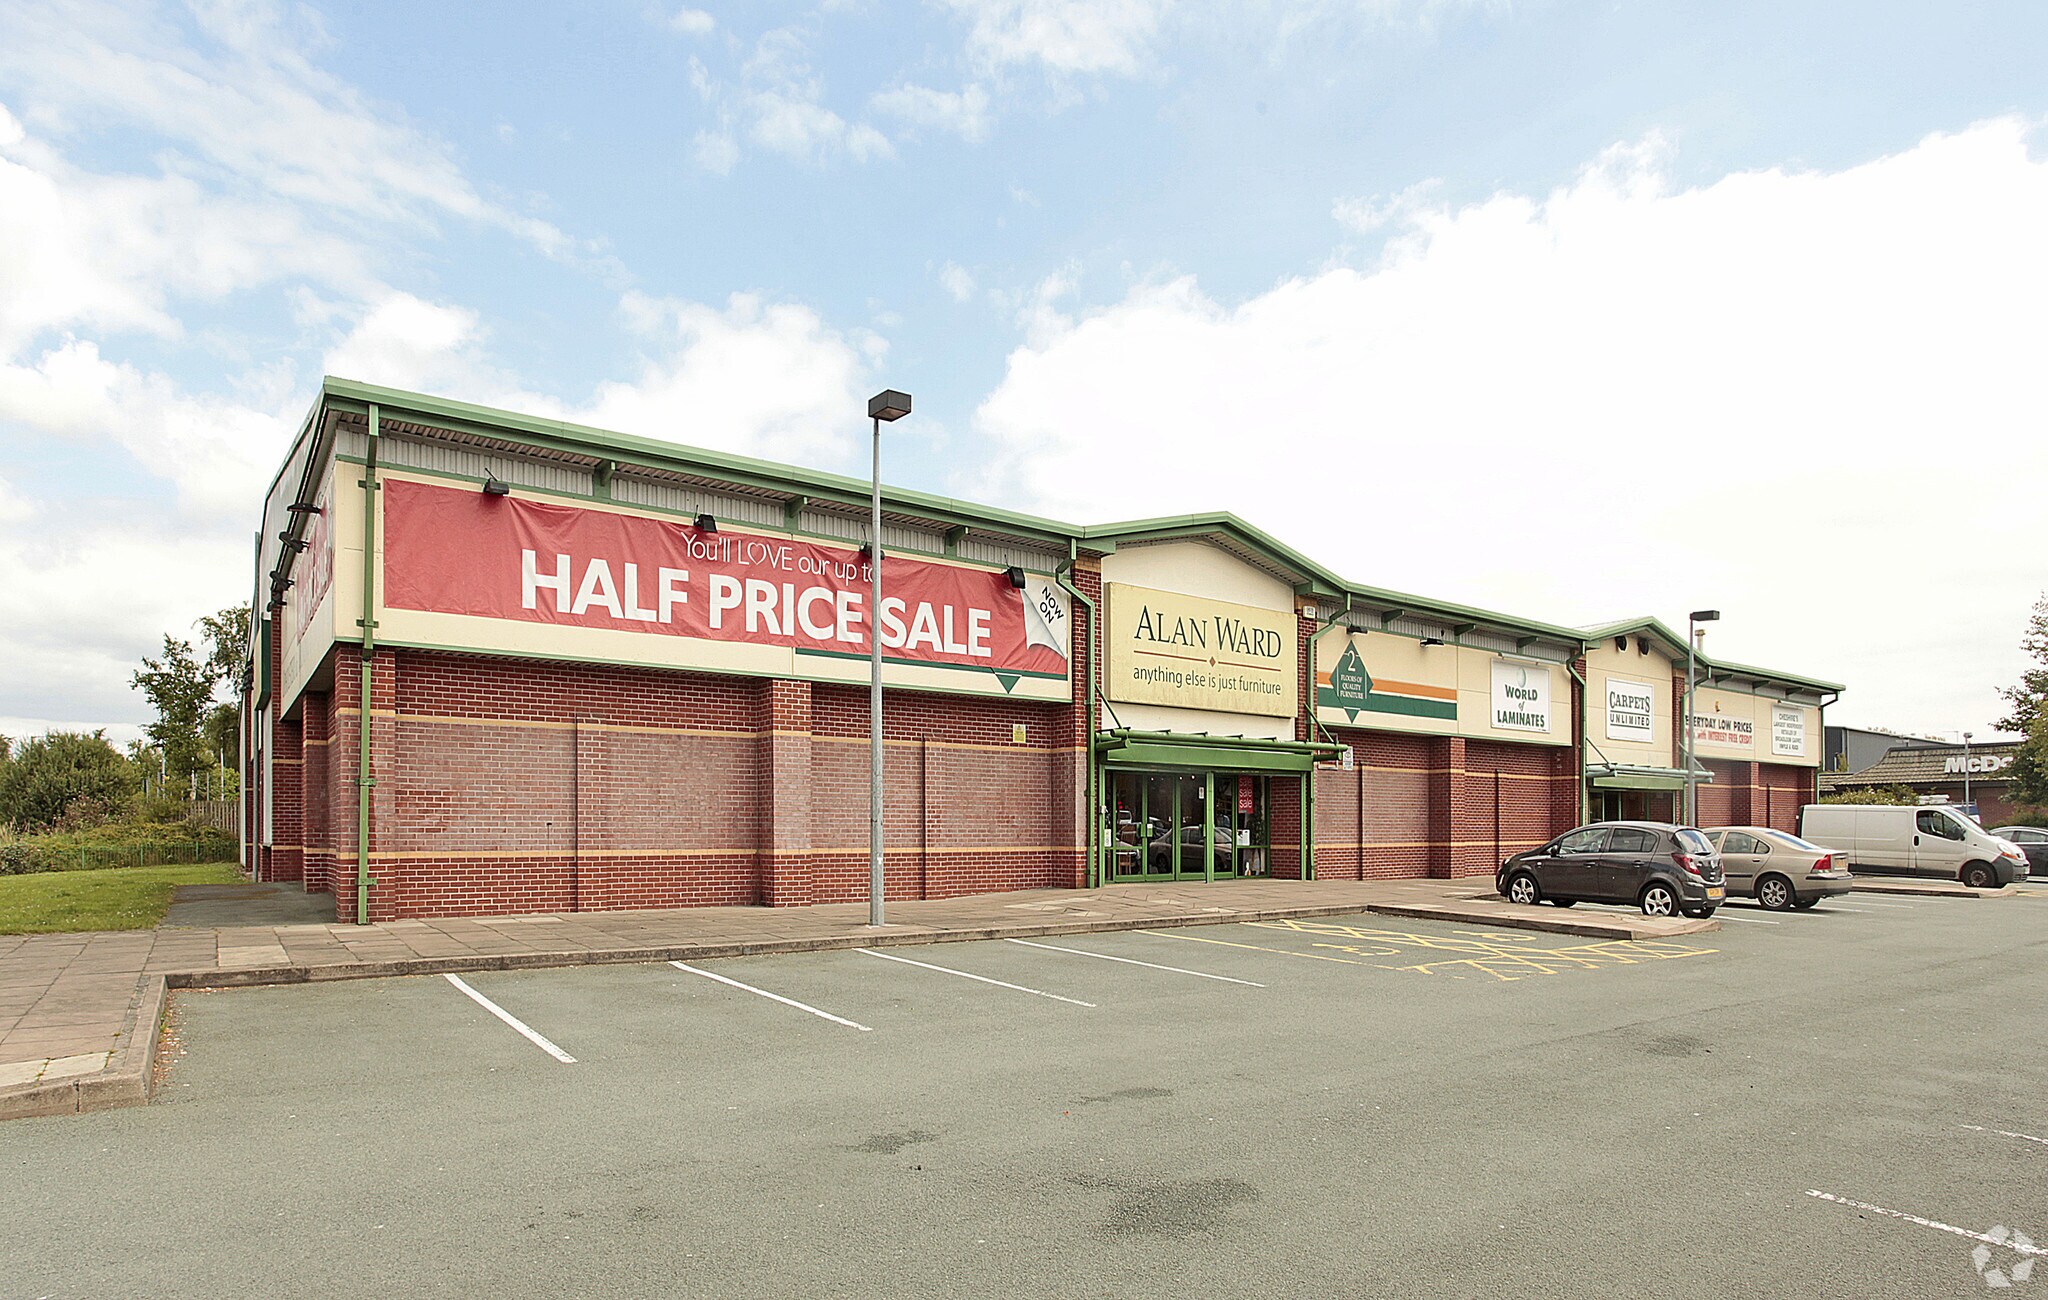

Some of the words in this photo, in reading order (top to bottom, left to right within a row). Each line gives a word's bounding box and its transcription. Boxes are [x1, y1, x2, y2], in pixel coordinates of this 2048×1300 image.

[681, 532, 731, 563] You'll
[798, 556, 829, 576] our
[835, 564, 857, 585] up
[522, 549, 689, 624] HALF
[709, 573, 863, 644] PRICE
[880, 597, 992, 657] SALE
[1042, 586, 1064, 619] NOW
[1040, 602, 1054, 624] ON
[1134, 605, 1207, 649] ALAN
[1214, 616, 1281, 658] WARD
[1347, 650, 1356, 672] 2
[1134, 665, 1183, 688] anything
[1185, 670, 1206, 687] else
[1208, 672, 1216, 688] is
[1218, 674, 1237, 692] just
[1239, 675, 1281, 696] furniture
[1342, 682, 1361, 691] QUALITY
[1505, 684, 1538, 701] WORLD
[1610, 691, 1650, 713] CARPETS
[1518, 701, 1525, 712] of
[1497, 710, 1545, 727] LAMINATES
[1610, 713, 1650, 726] UNLIMITED
[1685, 715, 1716, 729] EERYDAY
[1718, 718, 1731, 730] LOW
[1733, 720, 1752, 733] PRICES
[1239, 786, 1253, 797] sale
[1239, 797, 1253, 808] sale
